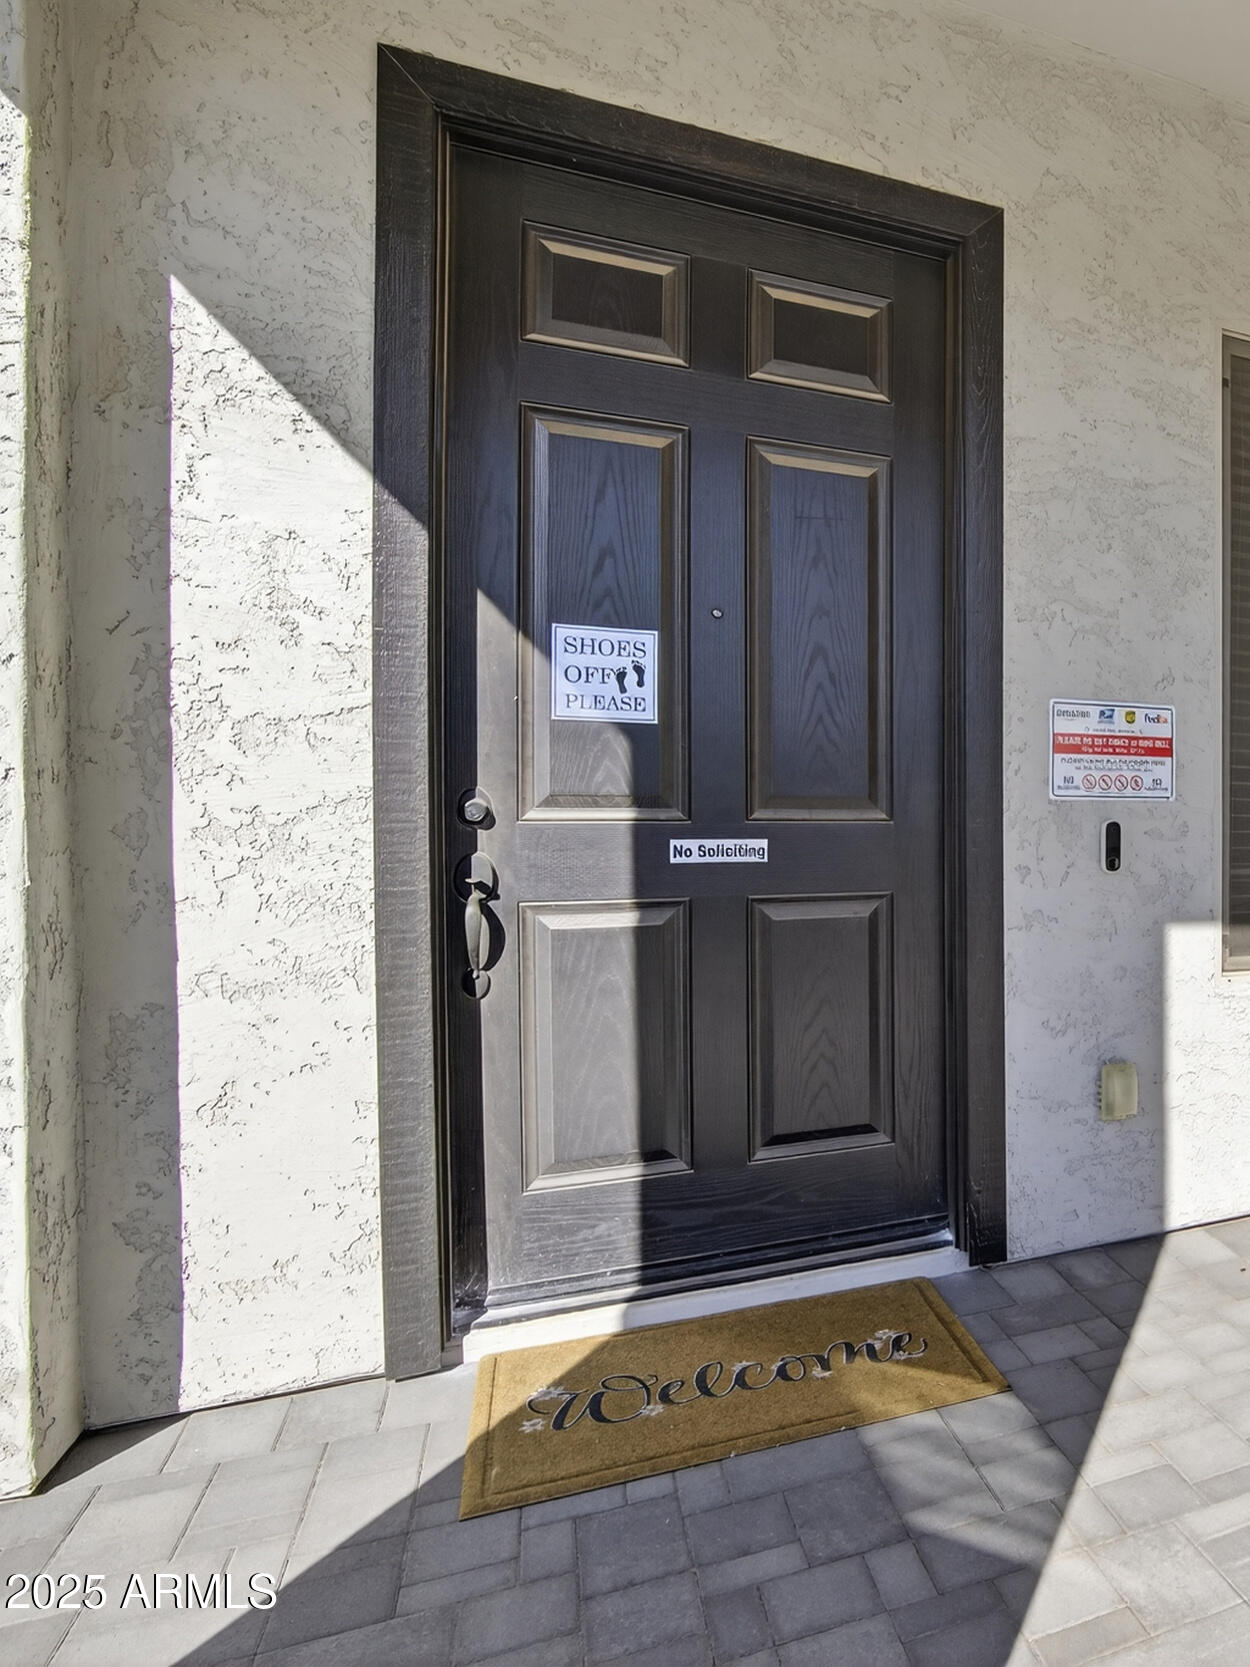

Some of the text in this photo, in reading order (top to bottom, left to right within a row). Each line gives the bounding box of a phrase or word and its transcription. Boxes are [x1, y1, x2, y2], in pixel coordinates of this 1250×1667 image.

[564, 635, 647, 659] SHOES
[564, 664, 616, 685] OFF
[566, 693, 647, 712] PLEASE
[673, 844, 766, 860] No Soliciting
[526, 1330, 929, 1432] Welcome
